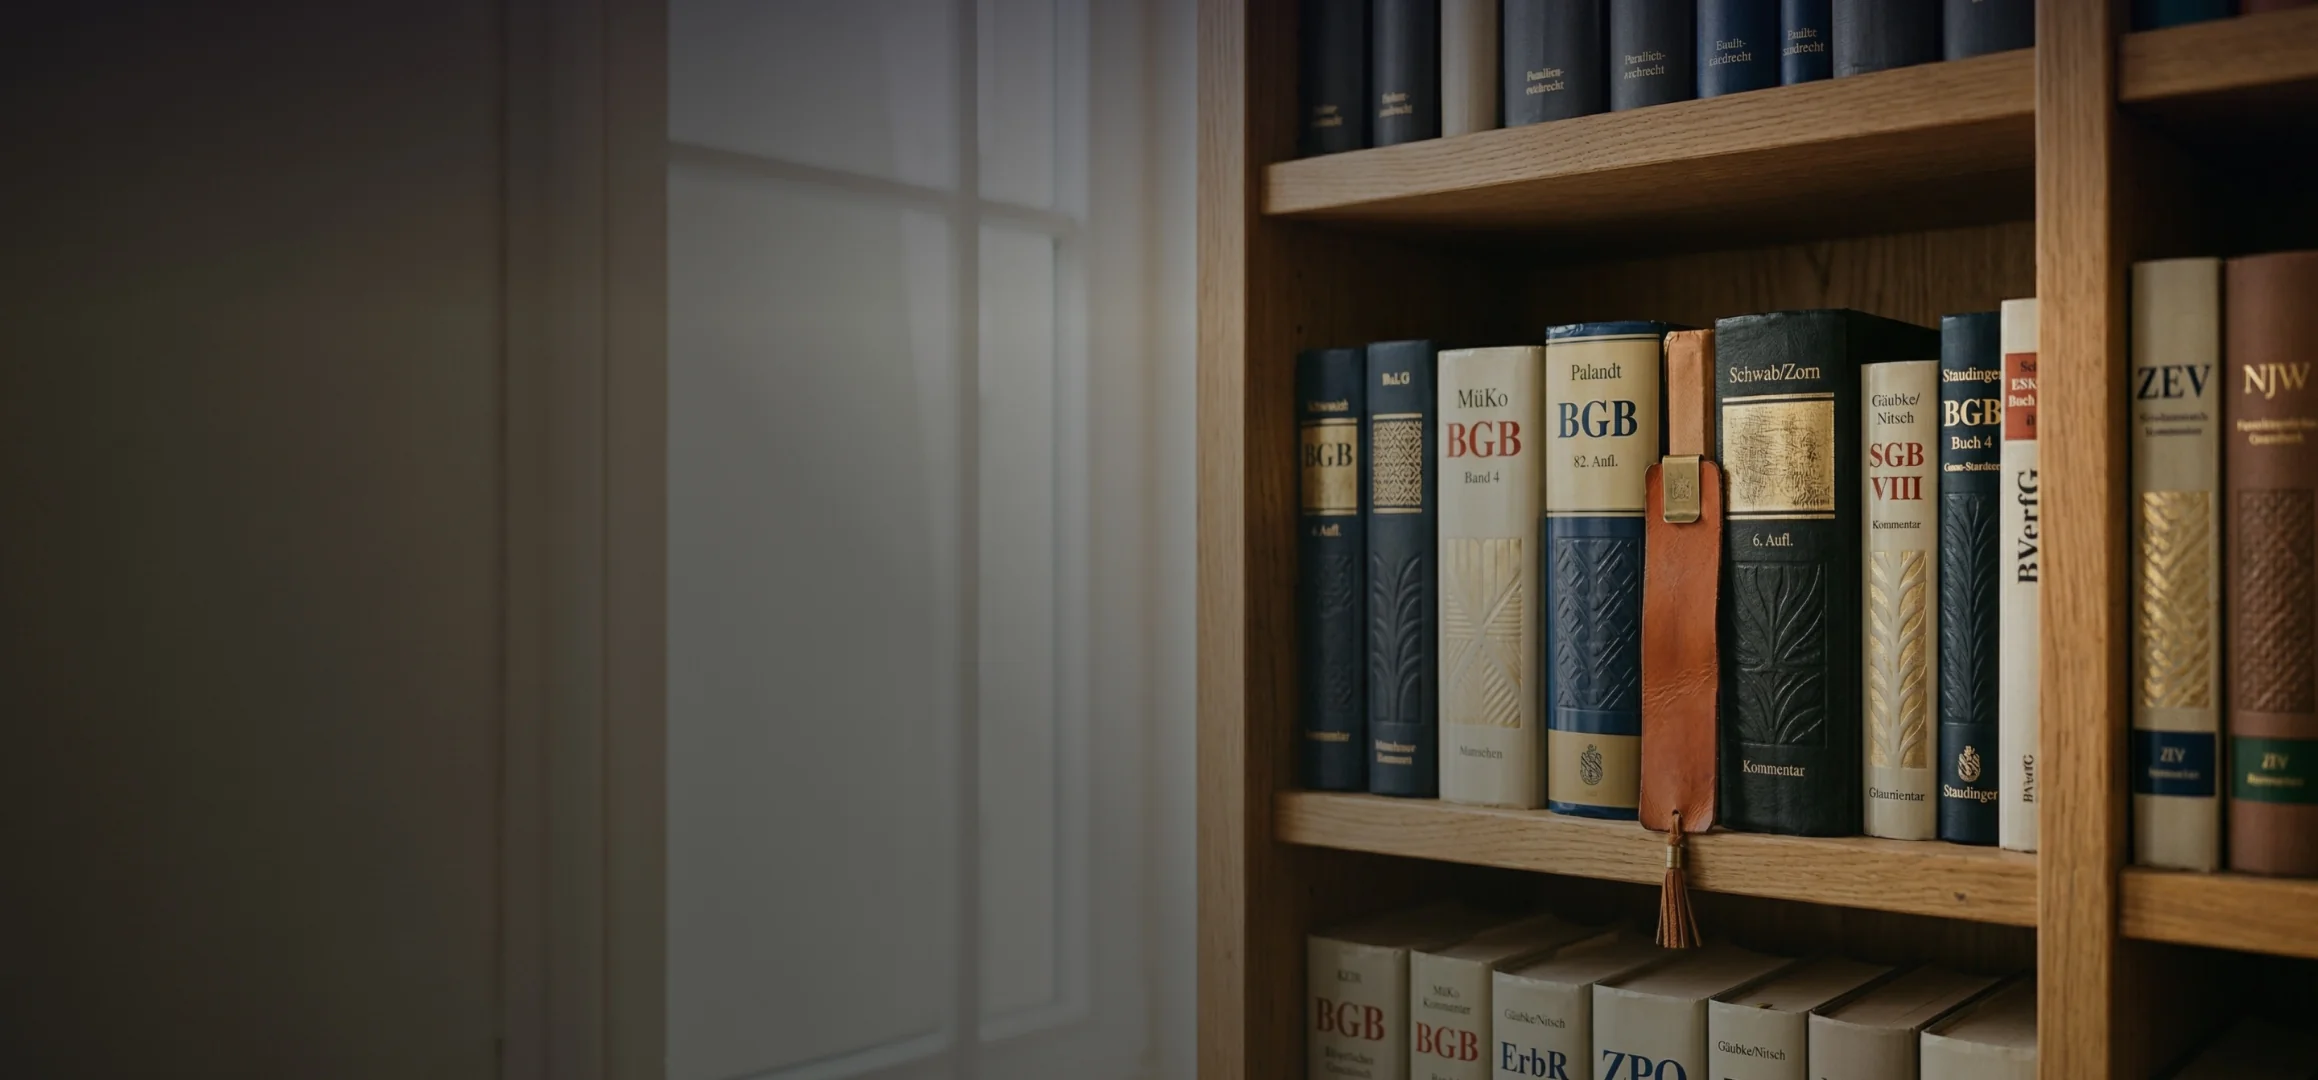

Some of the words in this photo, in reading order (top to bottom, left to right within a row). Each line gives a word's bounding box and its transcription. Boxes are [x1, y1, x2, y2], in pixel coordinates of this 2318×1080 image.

[1571, 363, 1622, 381] Palandt
[1729, 364, 1821, 384] Schwab/Zorn
[2137, 364, 2212, 400] ZEV
[2243, 363, 2310, 400] NJW
[1458, 388, 1508, 409] MüKo
[1872, 392, 1921, 408] Gäubke/
[1557, 400, 1638, 438] BGB
[1877, 411, 1914, 425] Nitsch
[1943, 398, 2001, 427] BGB
[1447, 421, 1522, 459] BGB
[1951, 437, 1981, 450] Buch
[1984, 435, 1992, 448] 4
[1305, 443, 1353, 468] BGB
[1573, 455, 1589, 468] 82.
[1870, 442, 1924, 468] SGB
[1465, 471, 1490, 484] Band
[1492, 470, 1500, 484] 4
[1871, 476, 1923, 501] VIII
[1872, 520, 1921, 530] Kommentar
[2018, 470, 2038, 584] BVerfG
[1752, 533, 1763, 547] 6.
[1766, 532, 1794, 547] Aufl.
[1743, 759, 1805, 777] Kommentar
[1943, 784, 1998, 803] Staudinger
[1315, 996, 1385, 1042] BGB
[1416, 1021, 1479, 1062] BGB
[1501, 1041, 1569, 1080] ErbR
